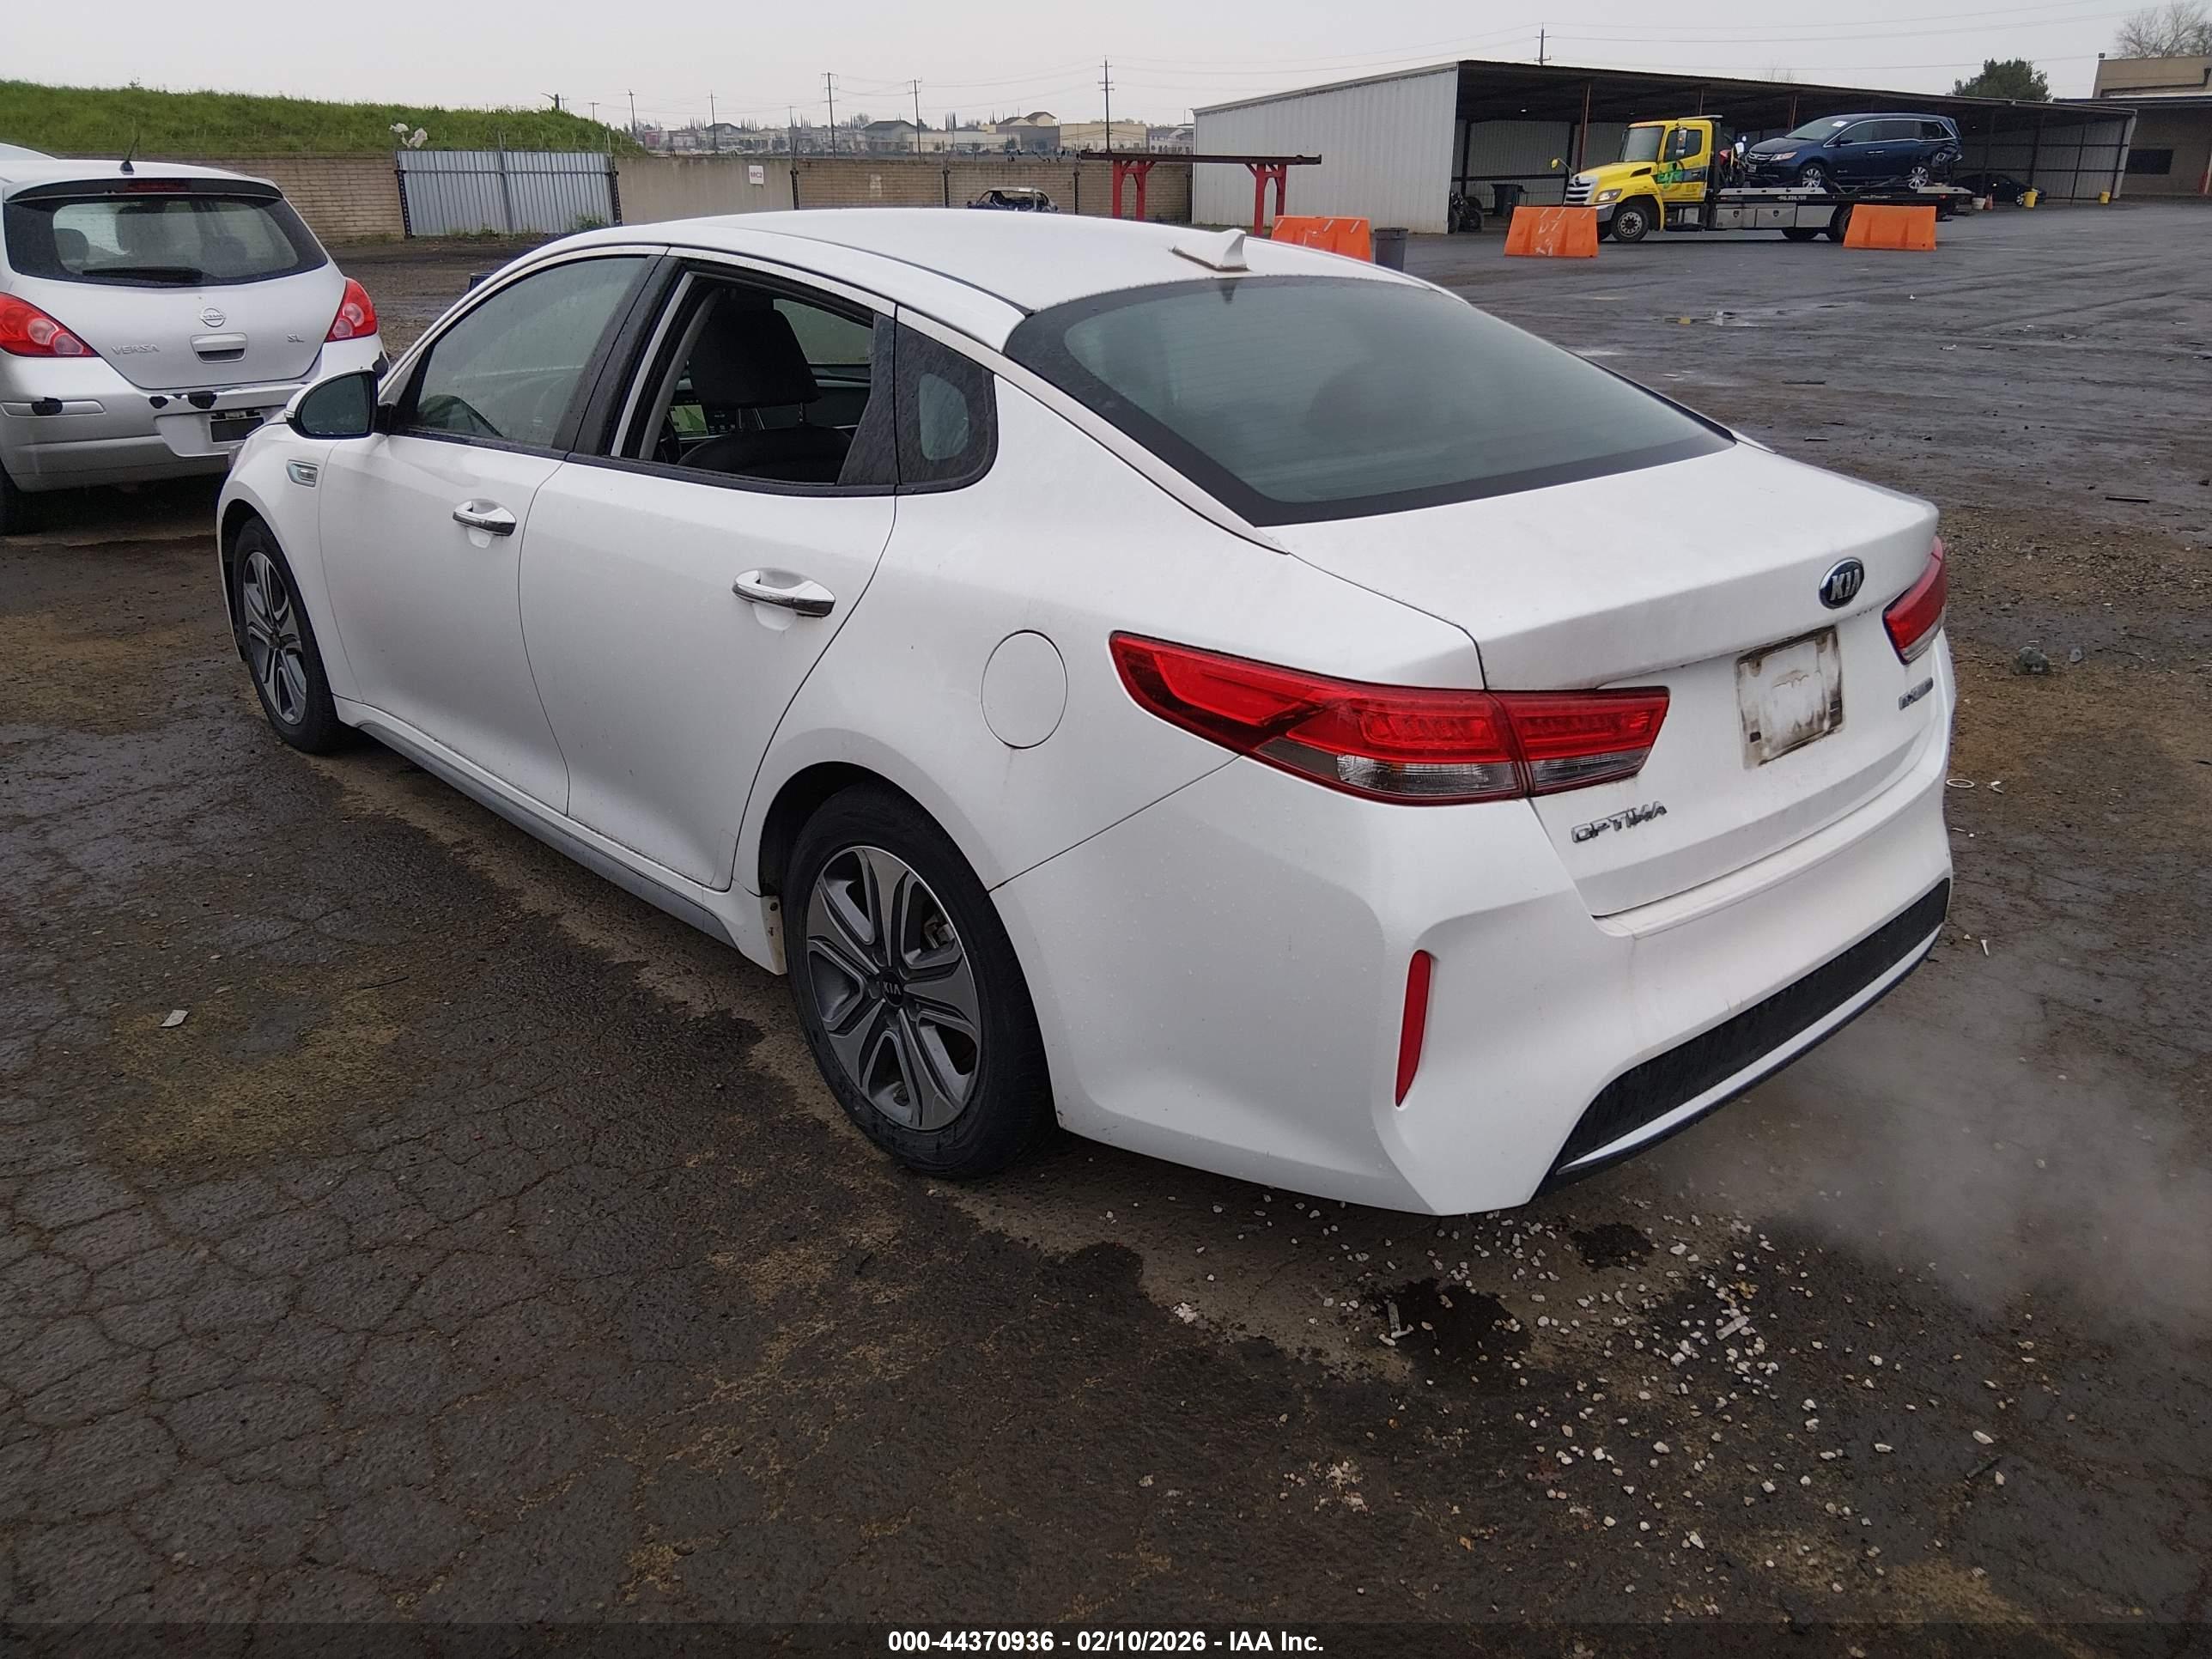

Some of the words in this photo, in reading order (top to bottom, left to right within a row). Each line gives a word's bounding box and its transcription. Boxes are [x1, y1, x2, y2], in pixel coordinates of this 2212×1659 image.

[288, 334, 304, 343] SL
[111, 343, 161, 356] VERSA
[1829, 568, 1860, 601] KIA
[1571, 799, 1668, 843] OPTIMA
[883, 981, 902, 995] KIA
